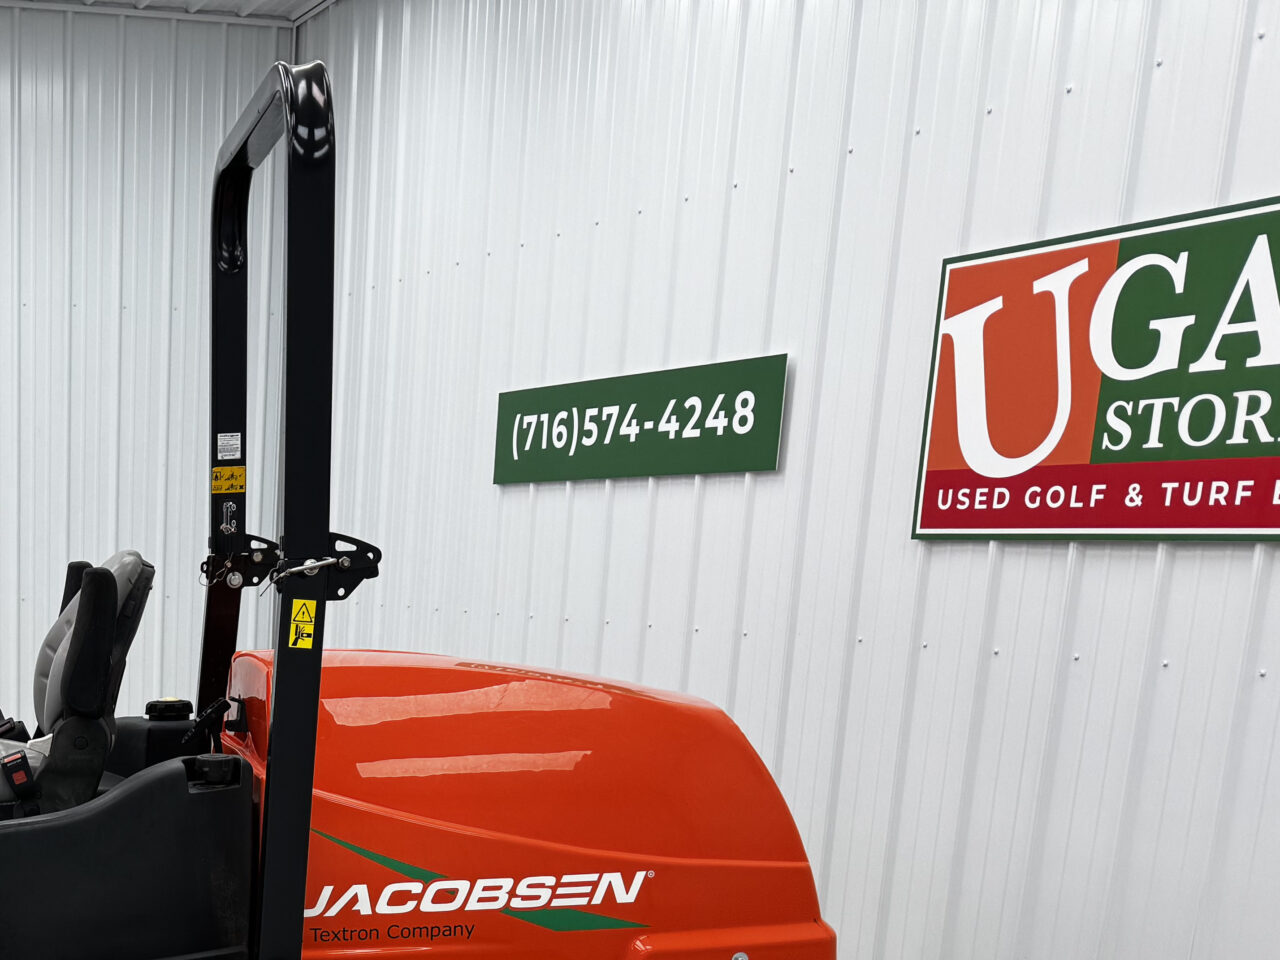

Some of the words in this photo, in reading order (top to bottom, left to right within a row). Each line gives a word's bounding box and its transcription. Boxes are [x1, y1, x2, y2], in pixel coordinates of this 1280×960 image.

[512, 390, 756, 461] (716)574-4248
[1101, 390, 1280, 451] STOR
[937, 487, 1011, 510] USED
[1024, 484, 1107, 509] GOLF
[1124, 483, 1144, 507] &
[1161, 480, 1255, 507] TURF
[304, 871, 648, 918] JACOBSEN
[309, 927, 380, 943] Textron
[387, 924, 475, 940] Company
